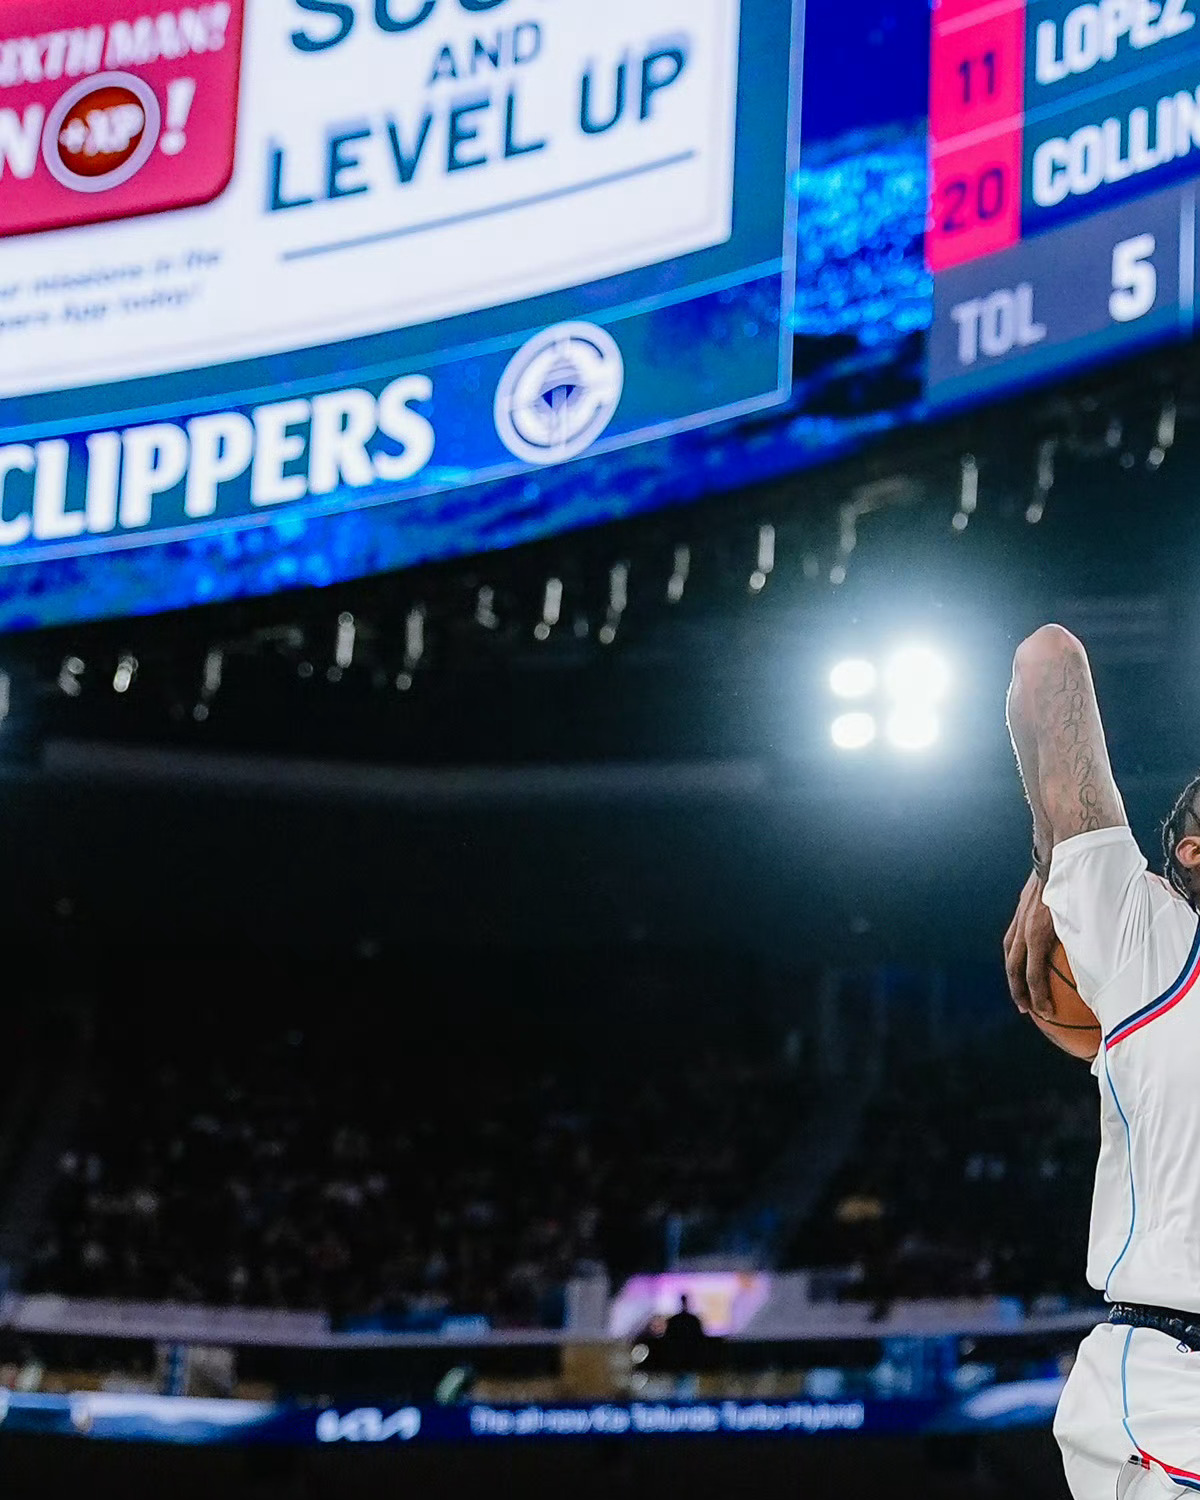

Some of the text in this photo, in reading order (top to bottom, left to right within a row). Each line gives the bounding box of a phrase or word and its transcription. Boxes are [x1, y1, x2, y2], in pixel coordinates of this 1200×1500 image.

[429, 21, 542, 84] AND
[958, 51, 996, 104] 11
[269, 40, 690, 212] LEVEL UP
[943, 167, 1004, 232] 20
[1108, 233, 1157, 322] 5
[950, 282, 1047, 366] TOL
[0, 374, 435, 546] CLIPPERS
